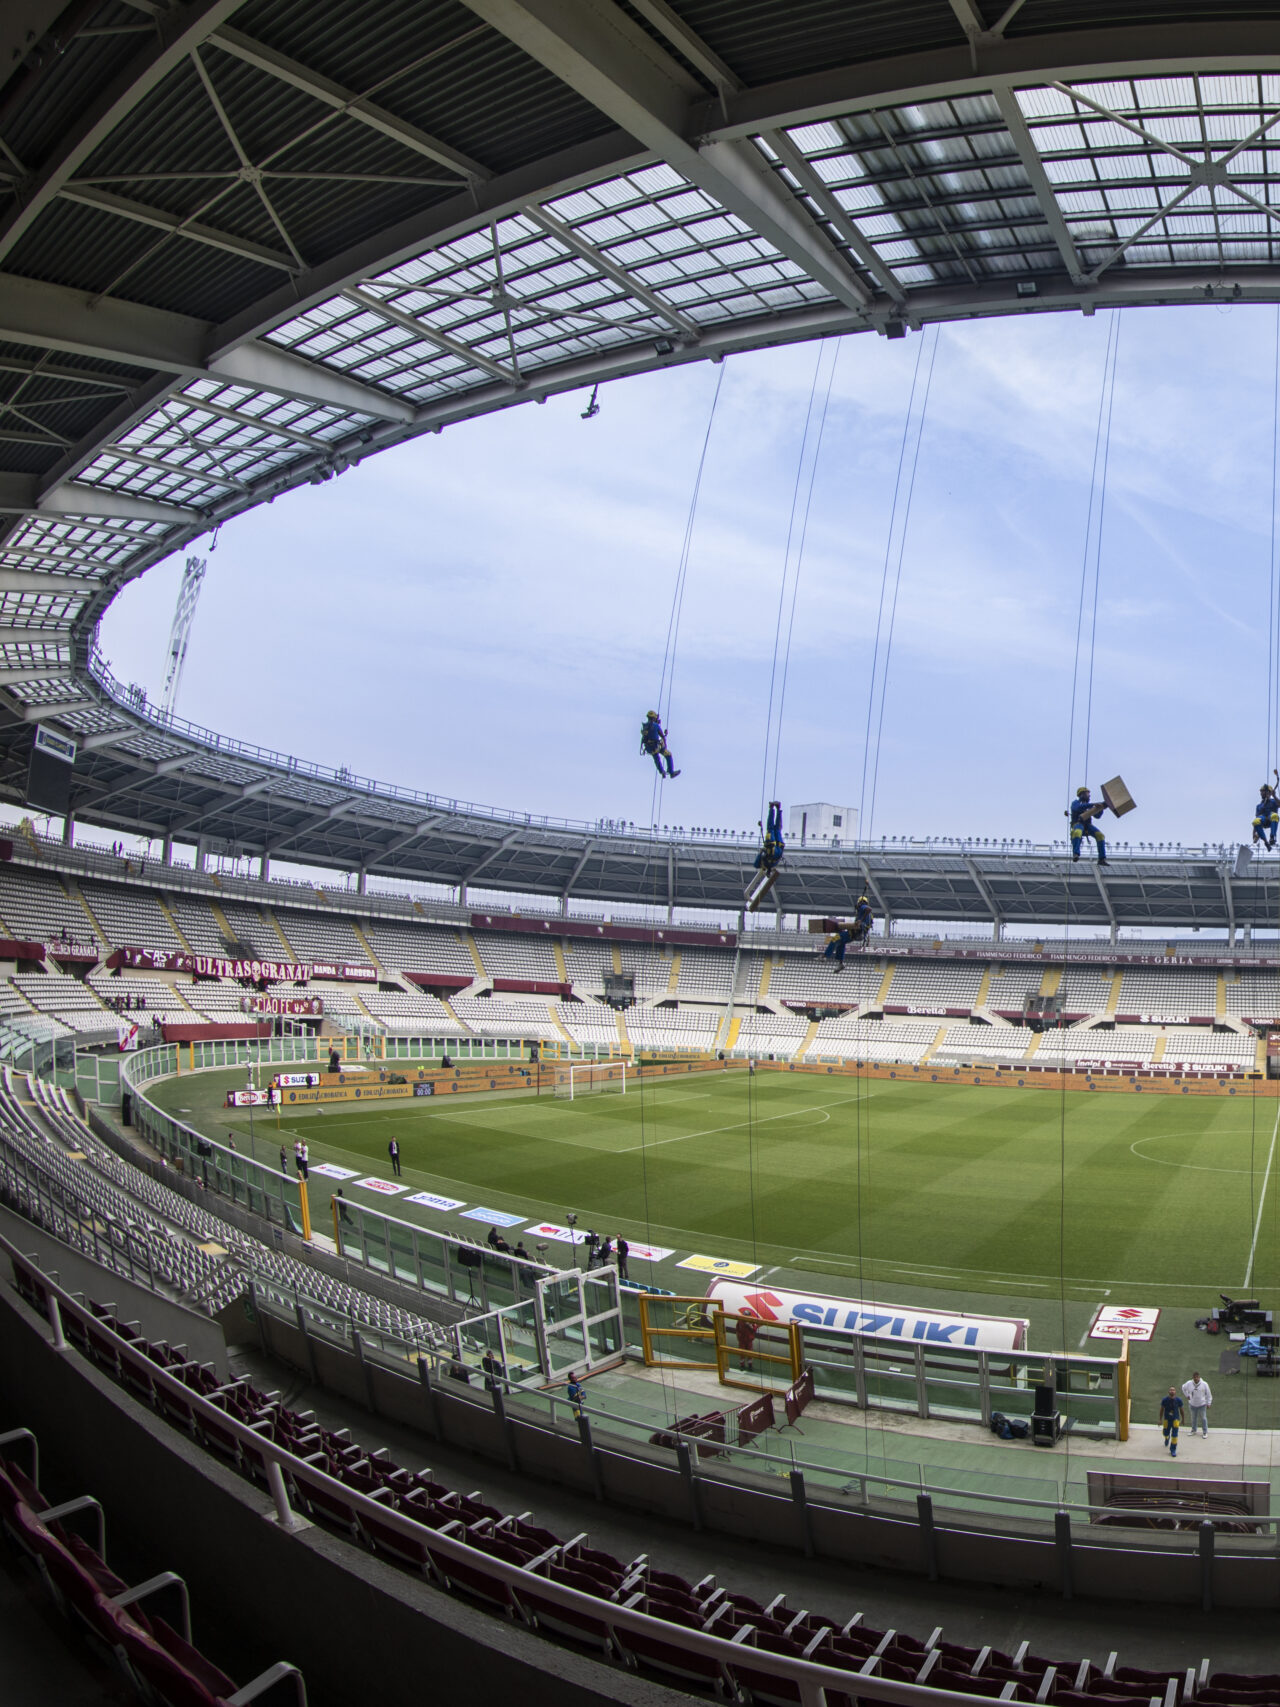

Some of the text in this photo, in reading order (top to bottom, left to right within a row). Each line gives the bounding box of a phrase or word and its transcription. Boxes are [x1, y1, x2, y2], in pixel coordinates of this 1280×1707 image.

[1154, 956, 1193, 965] GERLA
[195, 956, 312, 981] ULTRAS GRANAT
[313, 964, 336, 975] BANDA
[256, 997, 278, 1014] CIAO
[1151, 1015, 1190, 1024] SUZUKI
[1192, 1064, 1228, 1072] SUZUKI
[789, 1303, 980, 1346] SUZUKI
